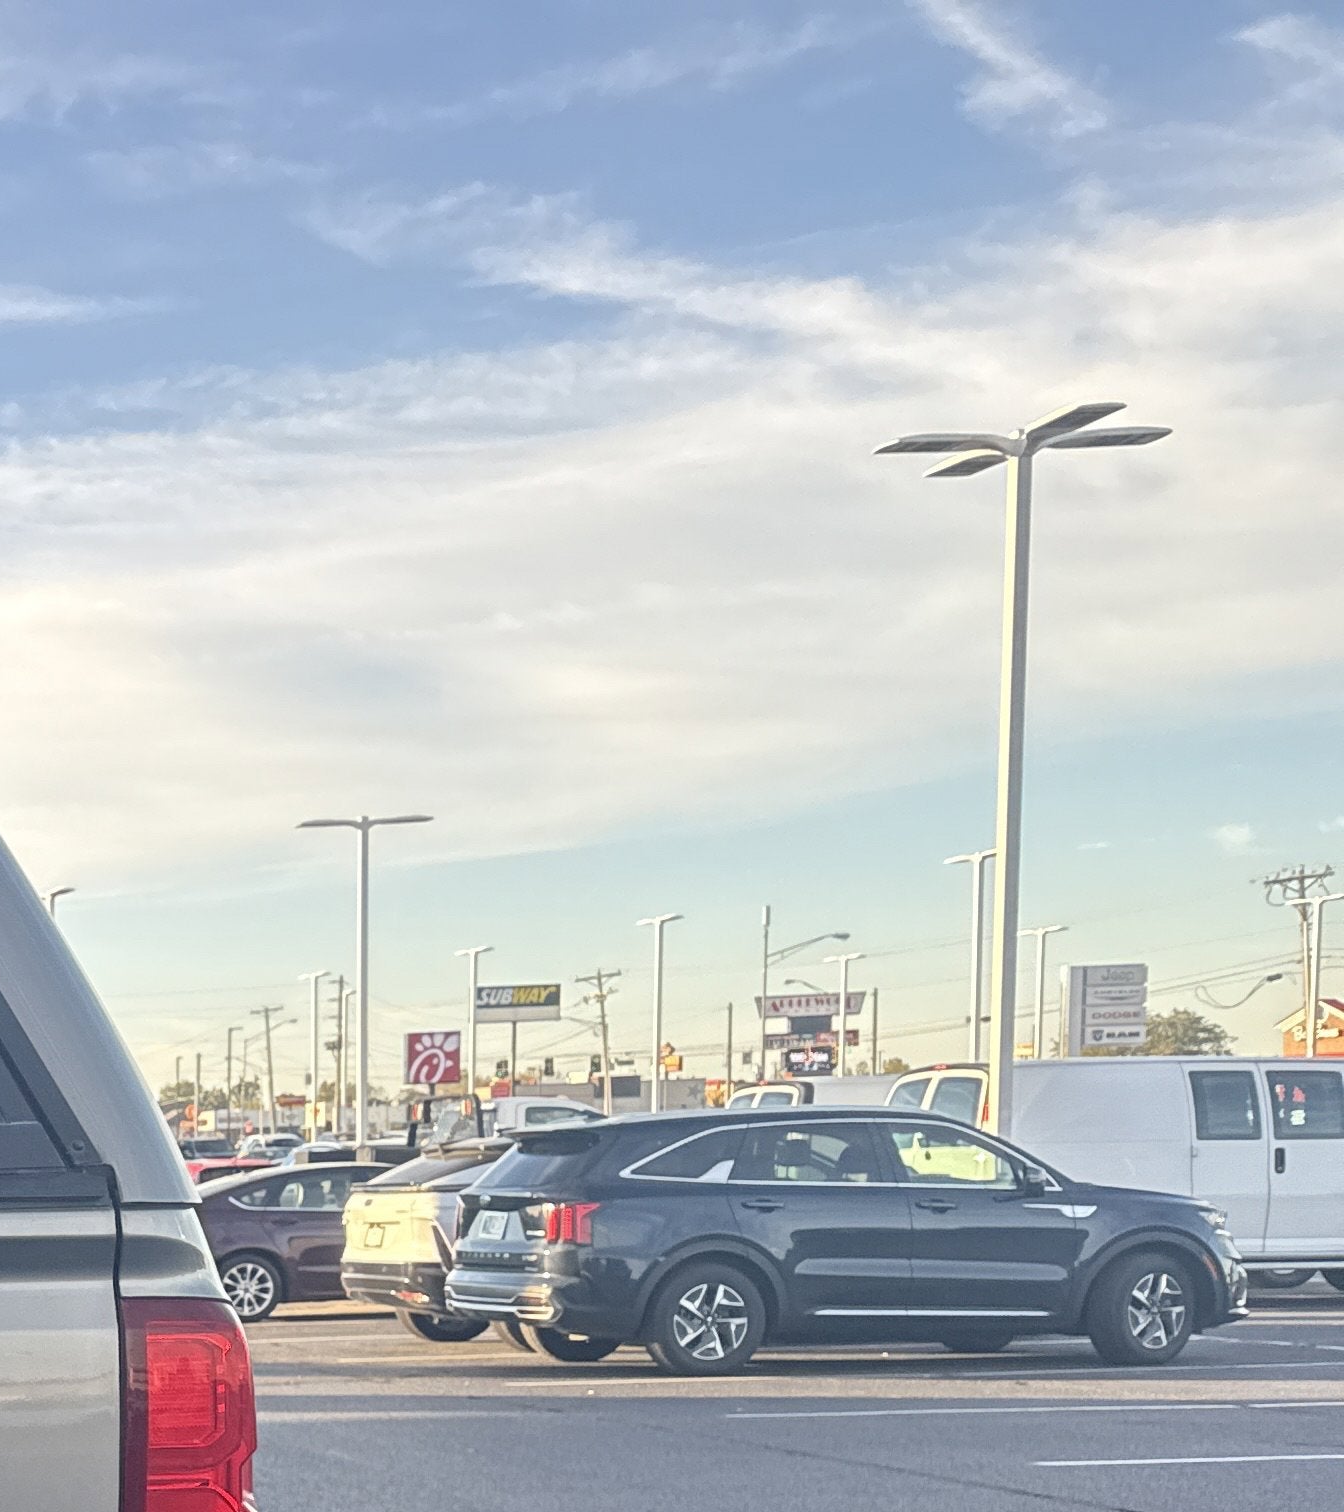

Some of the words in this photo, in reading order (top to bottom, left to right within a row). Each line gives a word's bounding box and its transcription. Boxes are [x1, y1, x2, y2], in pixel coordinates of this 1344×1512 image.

[1101, 968, 1134, 982] Jeep
[476, 987, 556, 1005] SUBWAY
[1092, 1011, 1139, 1020] DODGE
